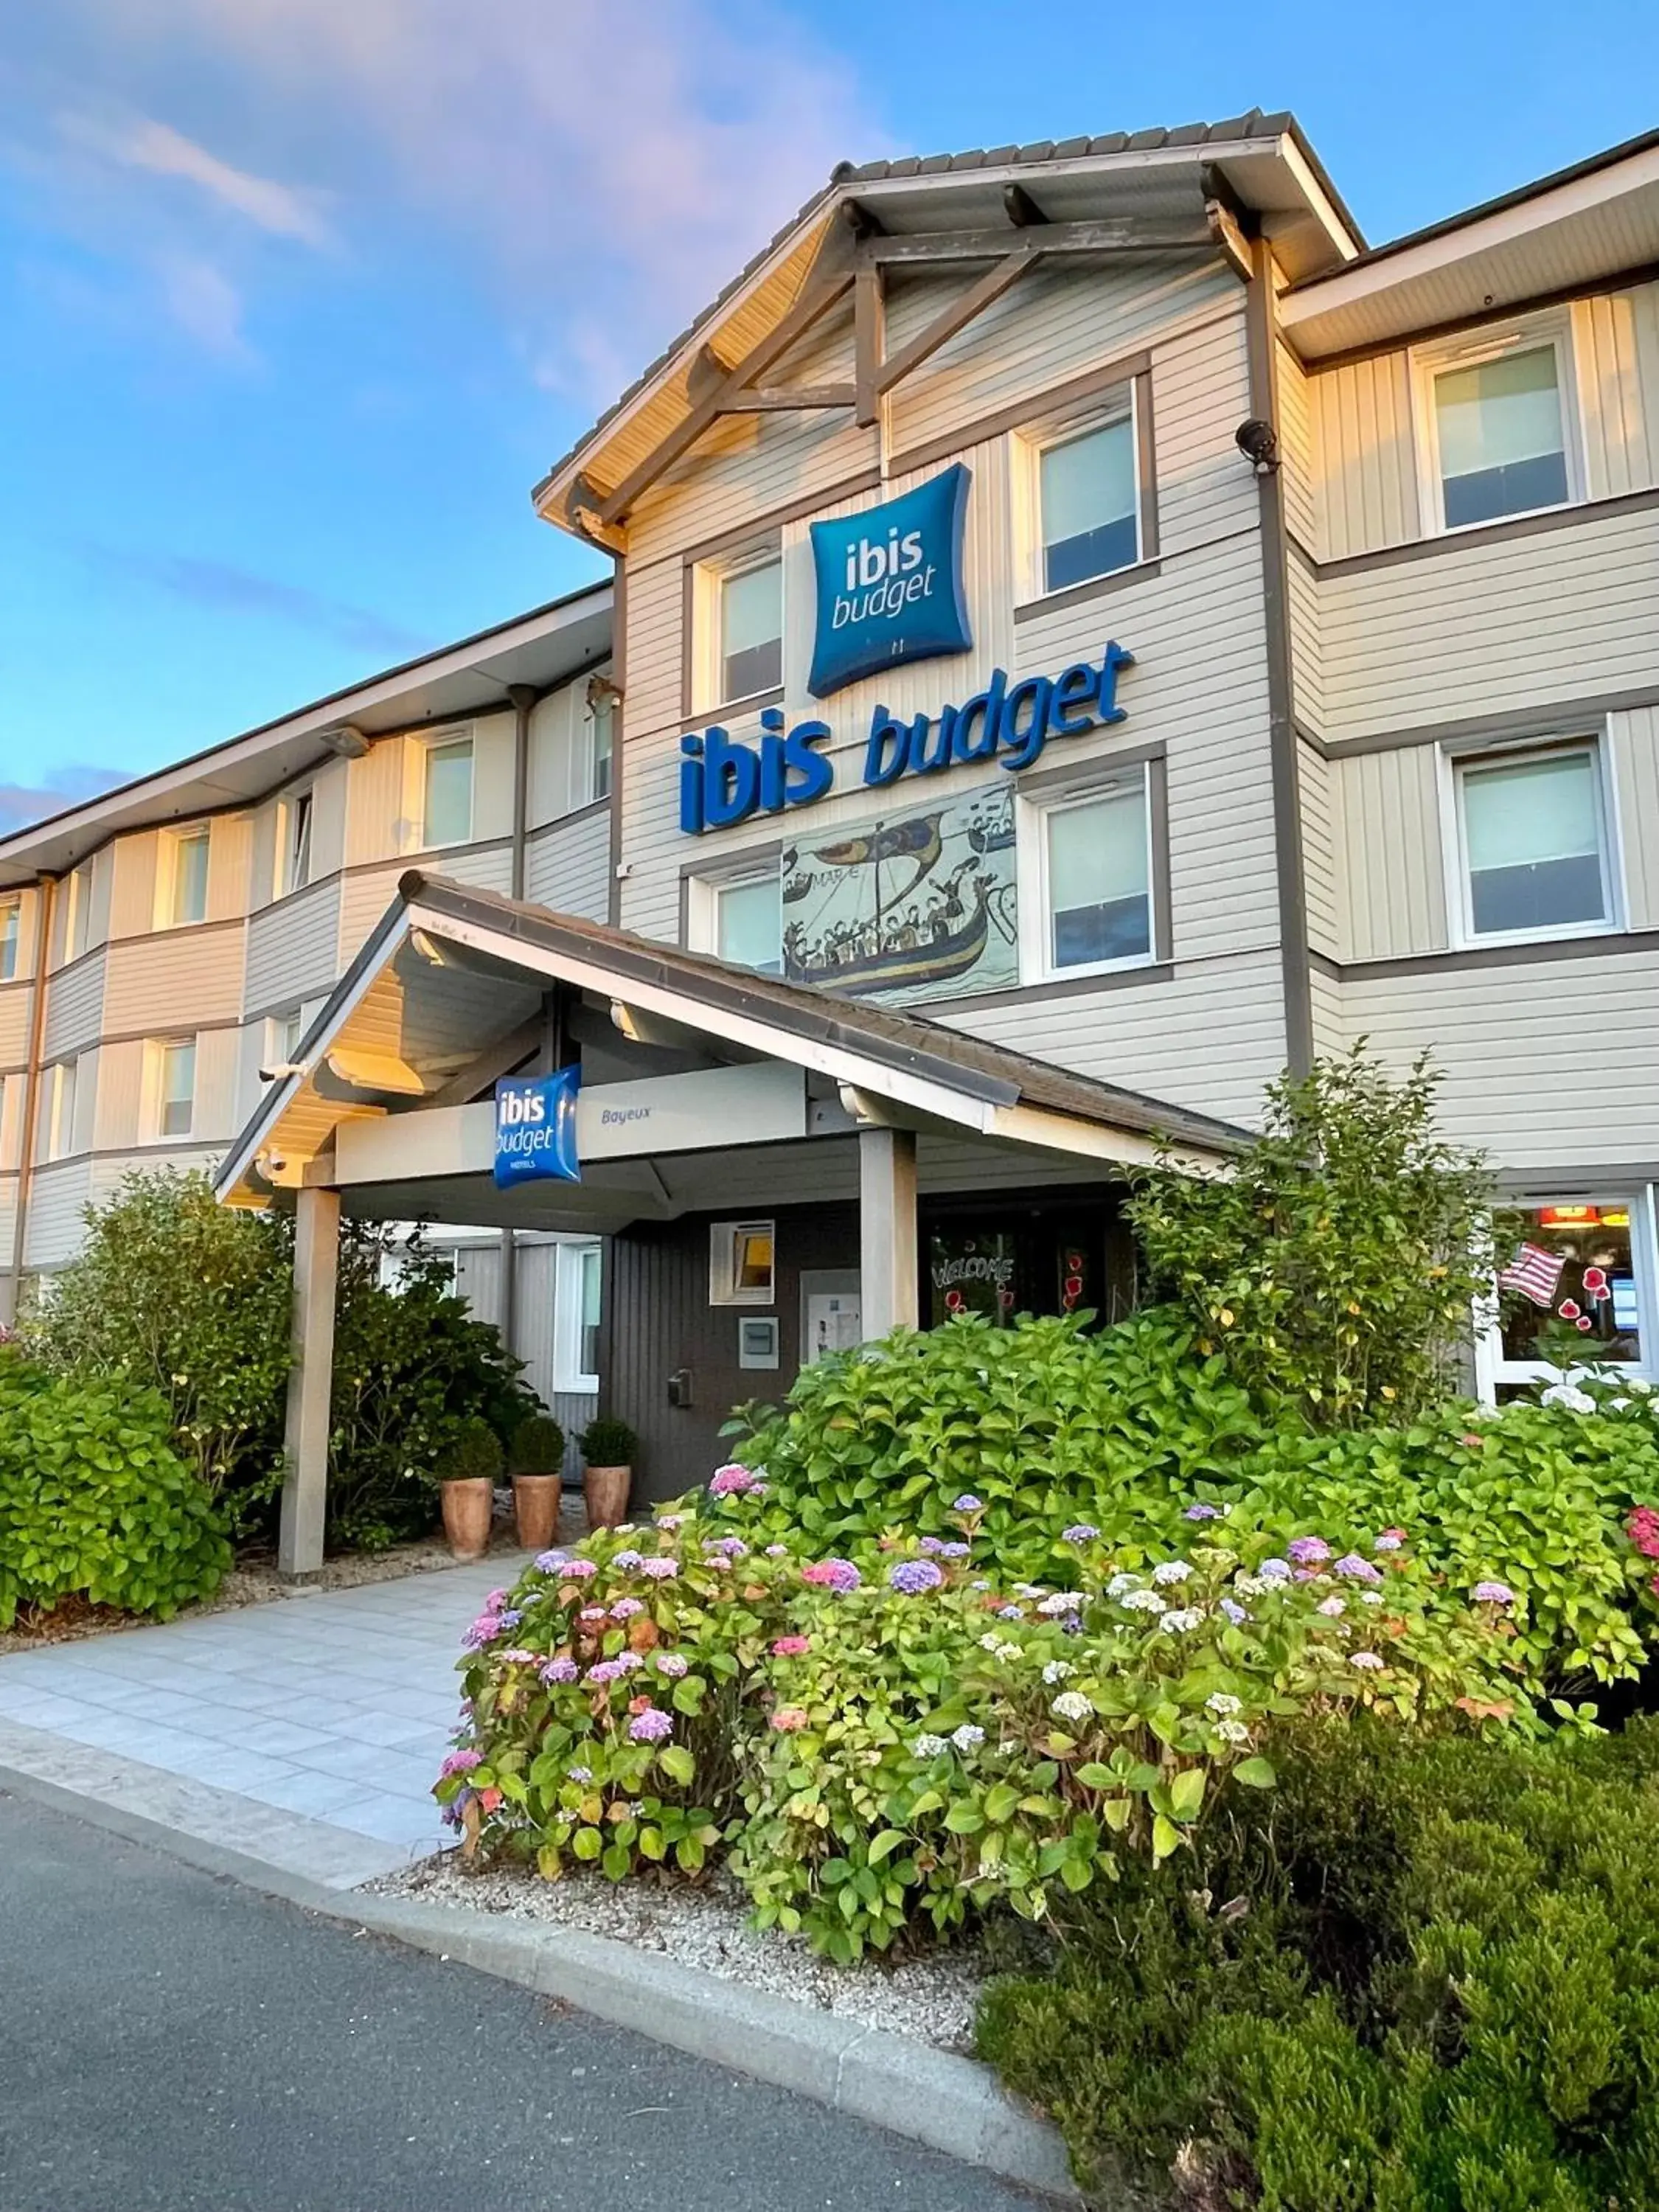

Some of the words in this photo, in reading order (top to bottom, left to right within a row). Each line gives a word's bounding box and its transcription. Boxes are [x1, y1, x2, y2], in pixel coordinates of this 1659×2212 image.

[846, 526, 923, 591] ibis
[832, 565, 937, 630] budget
[680, 707, 834, 836] ibis
[863, 639, 1135, 786] budget
[500, 1089, 546, 1125] ibis
[601, 1106, 652, 1125] Bayeux
[931, 1256, 1015, 1289] WELCOME
